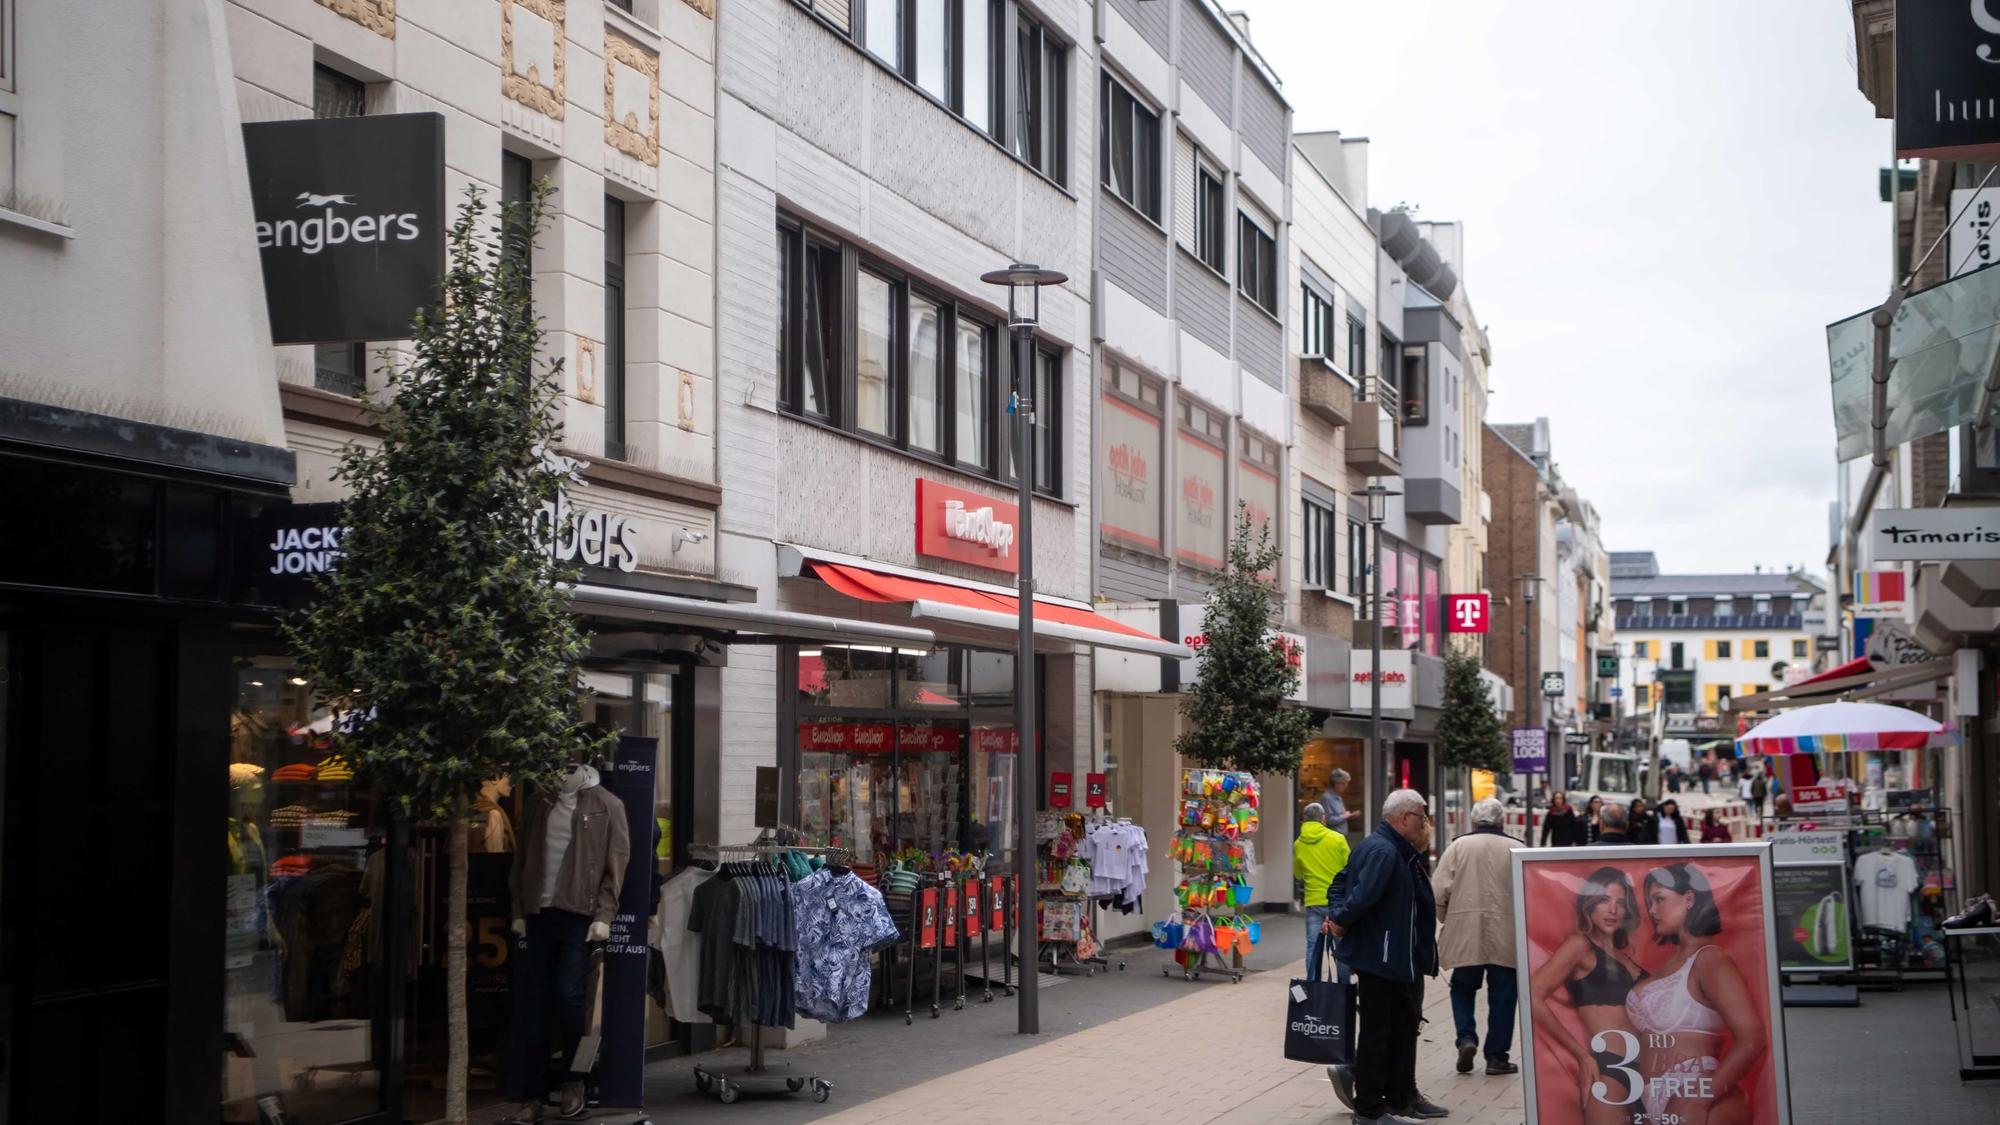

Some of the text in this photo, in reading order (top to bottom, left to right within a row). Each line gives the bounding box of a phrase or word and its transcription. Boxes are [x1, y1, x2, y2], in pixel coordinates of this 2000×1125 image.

[256, 207, 419, 254] engbers
[1970, 201, 1991, 269] aris
[1880, 526, 2000, 543] Tamaris
[270, 552, 347, 574] JONE
[1456, 599, 1480, 627] T
[1513, 737, 1545, 746] ARSCH
[1514, 746, 1545, 758] LOCH
[618, 763, 650, 772] engbers
[614, 914, 635, 923] ANN
[610, 924, 630, 933] EIN.
[606, 944, 646, 954] GUT AUS!
[1291, 1020, 1340, 1036] engbers
[1591, 1029, 1675, 1105] 3 RD
[1649, 1077, 1715, 1098] FREE
